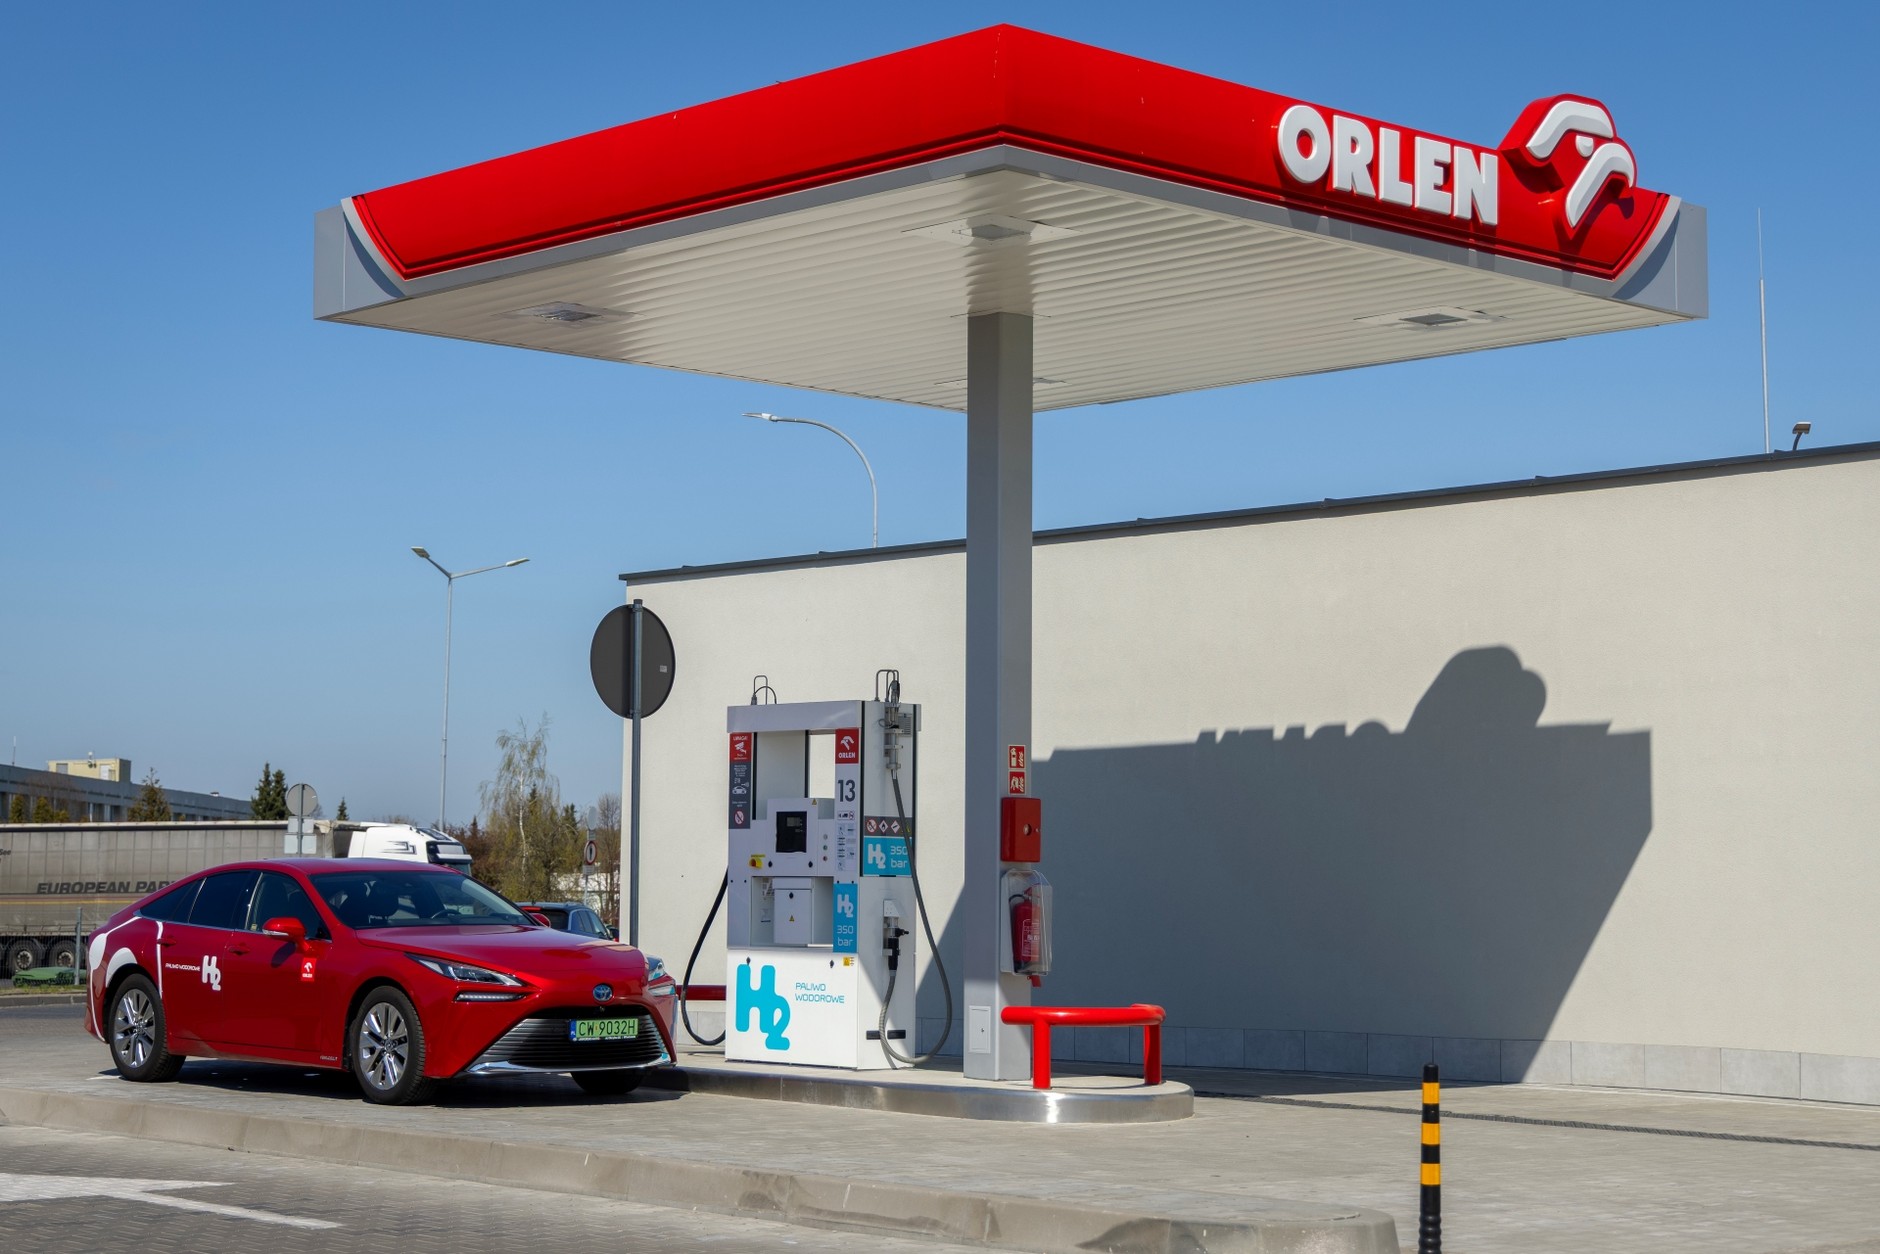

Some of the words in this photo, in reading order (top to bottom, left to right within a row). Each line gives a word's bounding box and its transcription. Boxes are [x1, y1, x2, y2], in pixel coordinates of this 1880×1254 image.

[1277, 104, 1498, 226] ORLEN
[837, 779, 856, 802] 13
[890, 845, 908, 856] 350
[890, 858, 908, 868] bar
[36, 881, 130, 894] EUROPEAN
[836, 925, 854, 934] 350
[837, 937, 854, 947] bar
[795, 982, 826, 991] PALIWO
[795, 993, 845, 1004] WODOROWE
[735, 963, 791, 1051] H2
[578, 1021, 595, 1036] CW
[599, 1020, 636, 1036] 9032H
